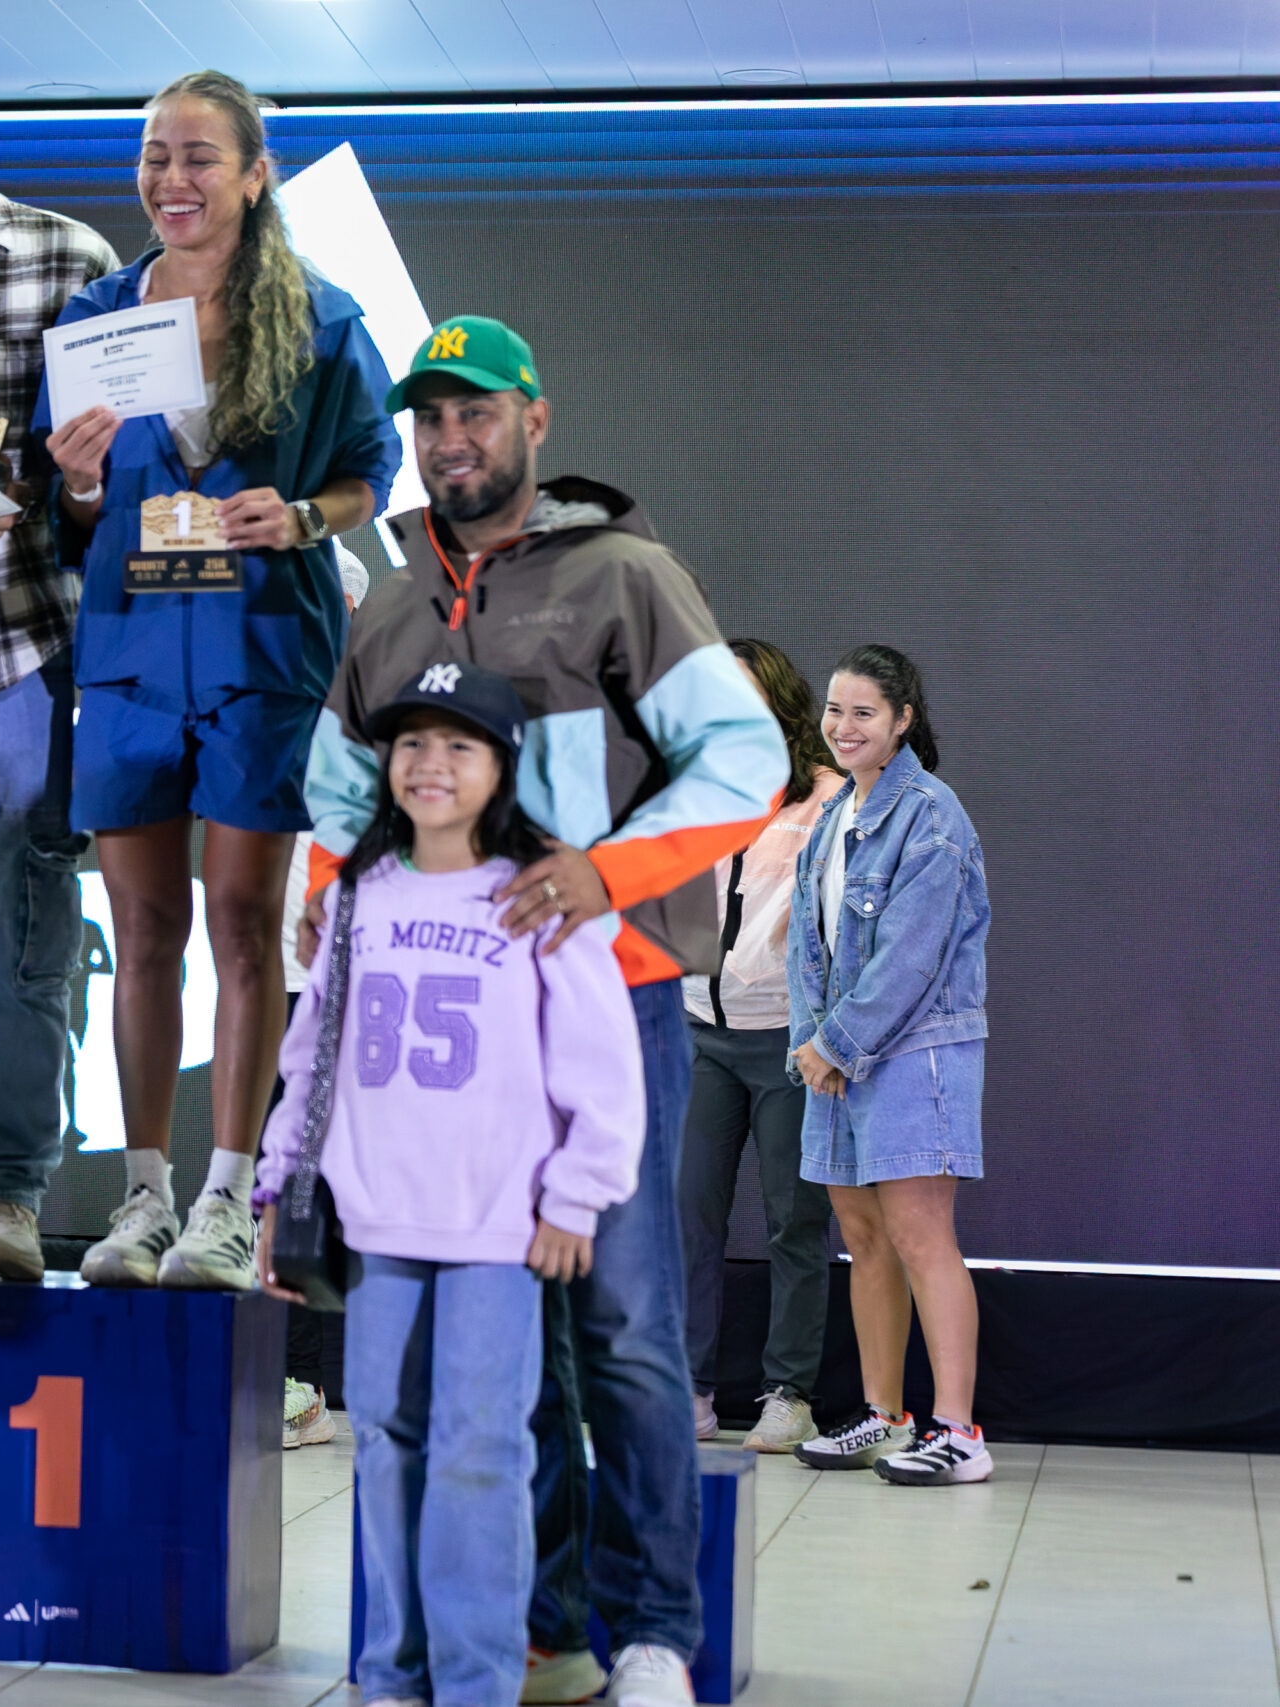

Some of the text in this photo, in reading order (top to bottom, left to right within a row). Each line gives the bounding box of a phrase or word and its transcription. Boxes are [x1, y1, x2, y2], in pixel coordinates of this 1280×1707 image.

[428, 327, 468, 360] NY
[172, 500, 191, 537] 1
[417, 663, 462, 693] NY
[390, 920, 509, 968] MORITZ
[356, 972, 480, 1092] 85
[9, 1375, 83, 1529] 1
[835, 1425, 892, 1455] TERREX
